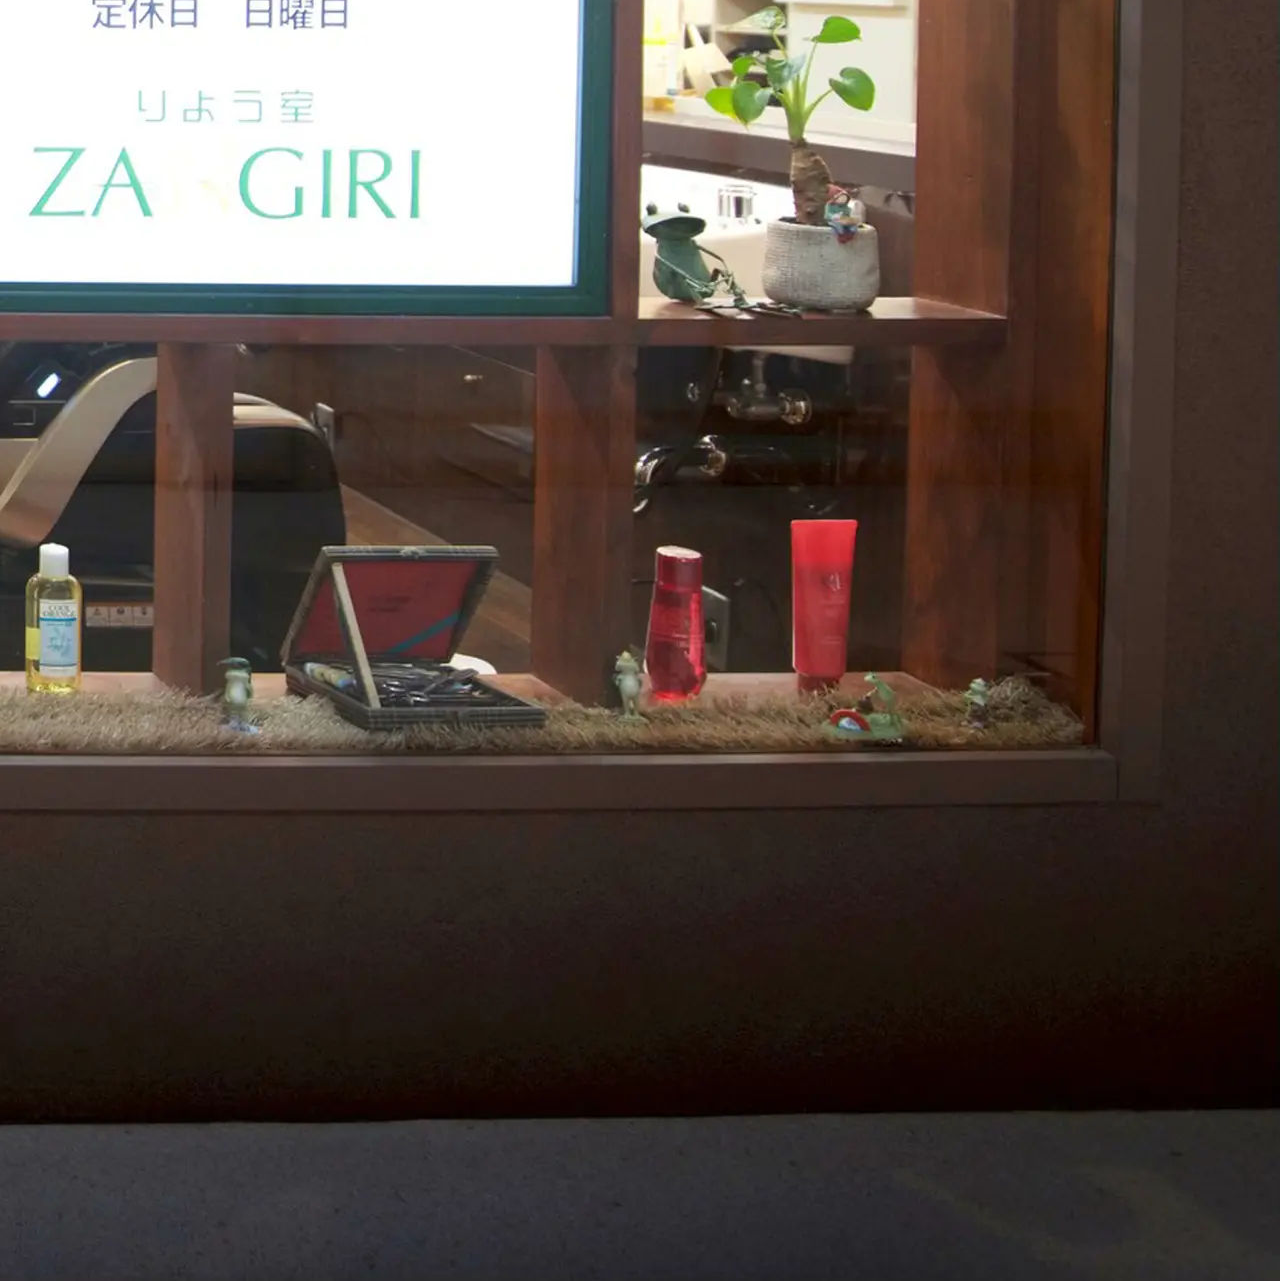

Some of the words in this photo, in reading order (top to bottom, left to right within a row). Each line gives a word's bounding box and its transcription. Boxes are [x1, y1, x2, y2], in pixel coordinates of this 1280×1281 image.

[137, 89, 314, 123] りよう室
[28, 146, 421, 220] ZAGIRI
